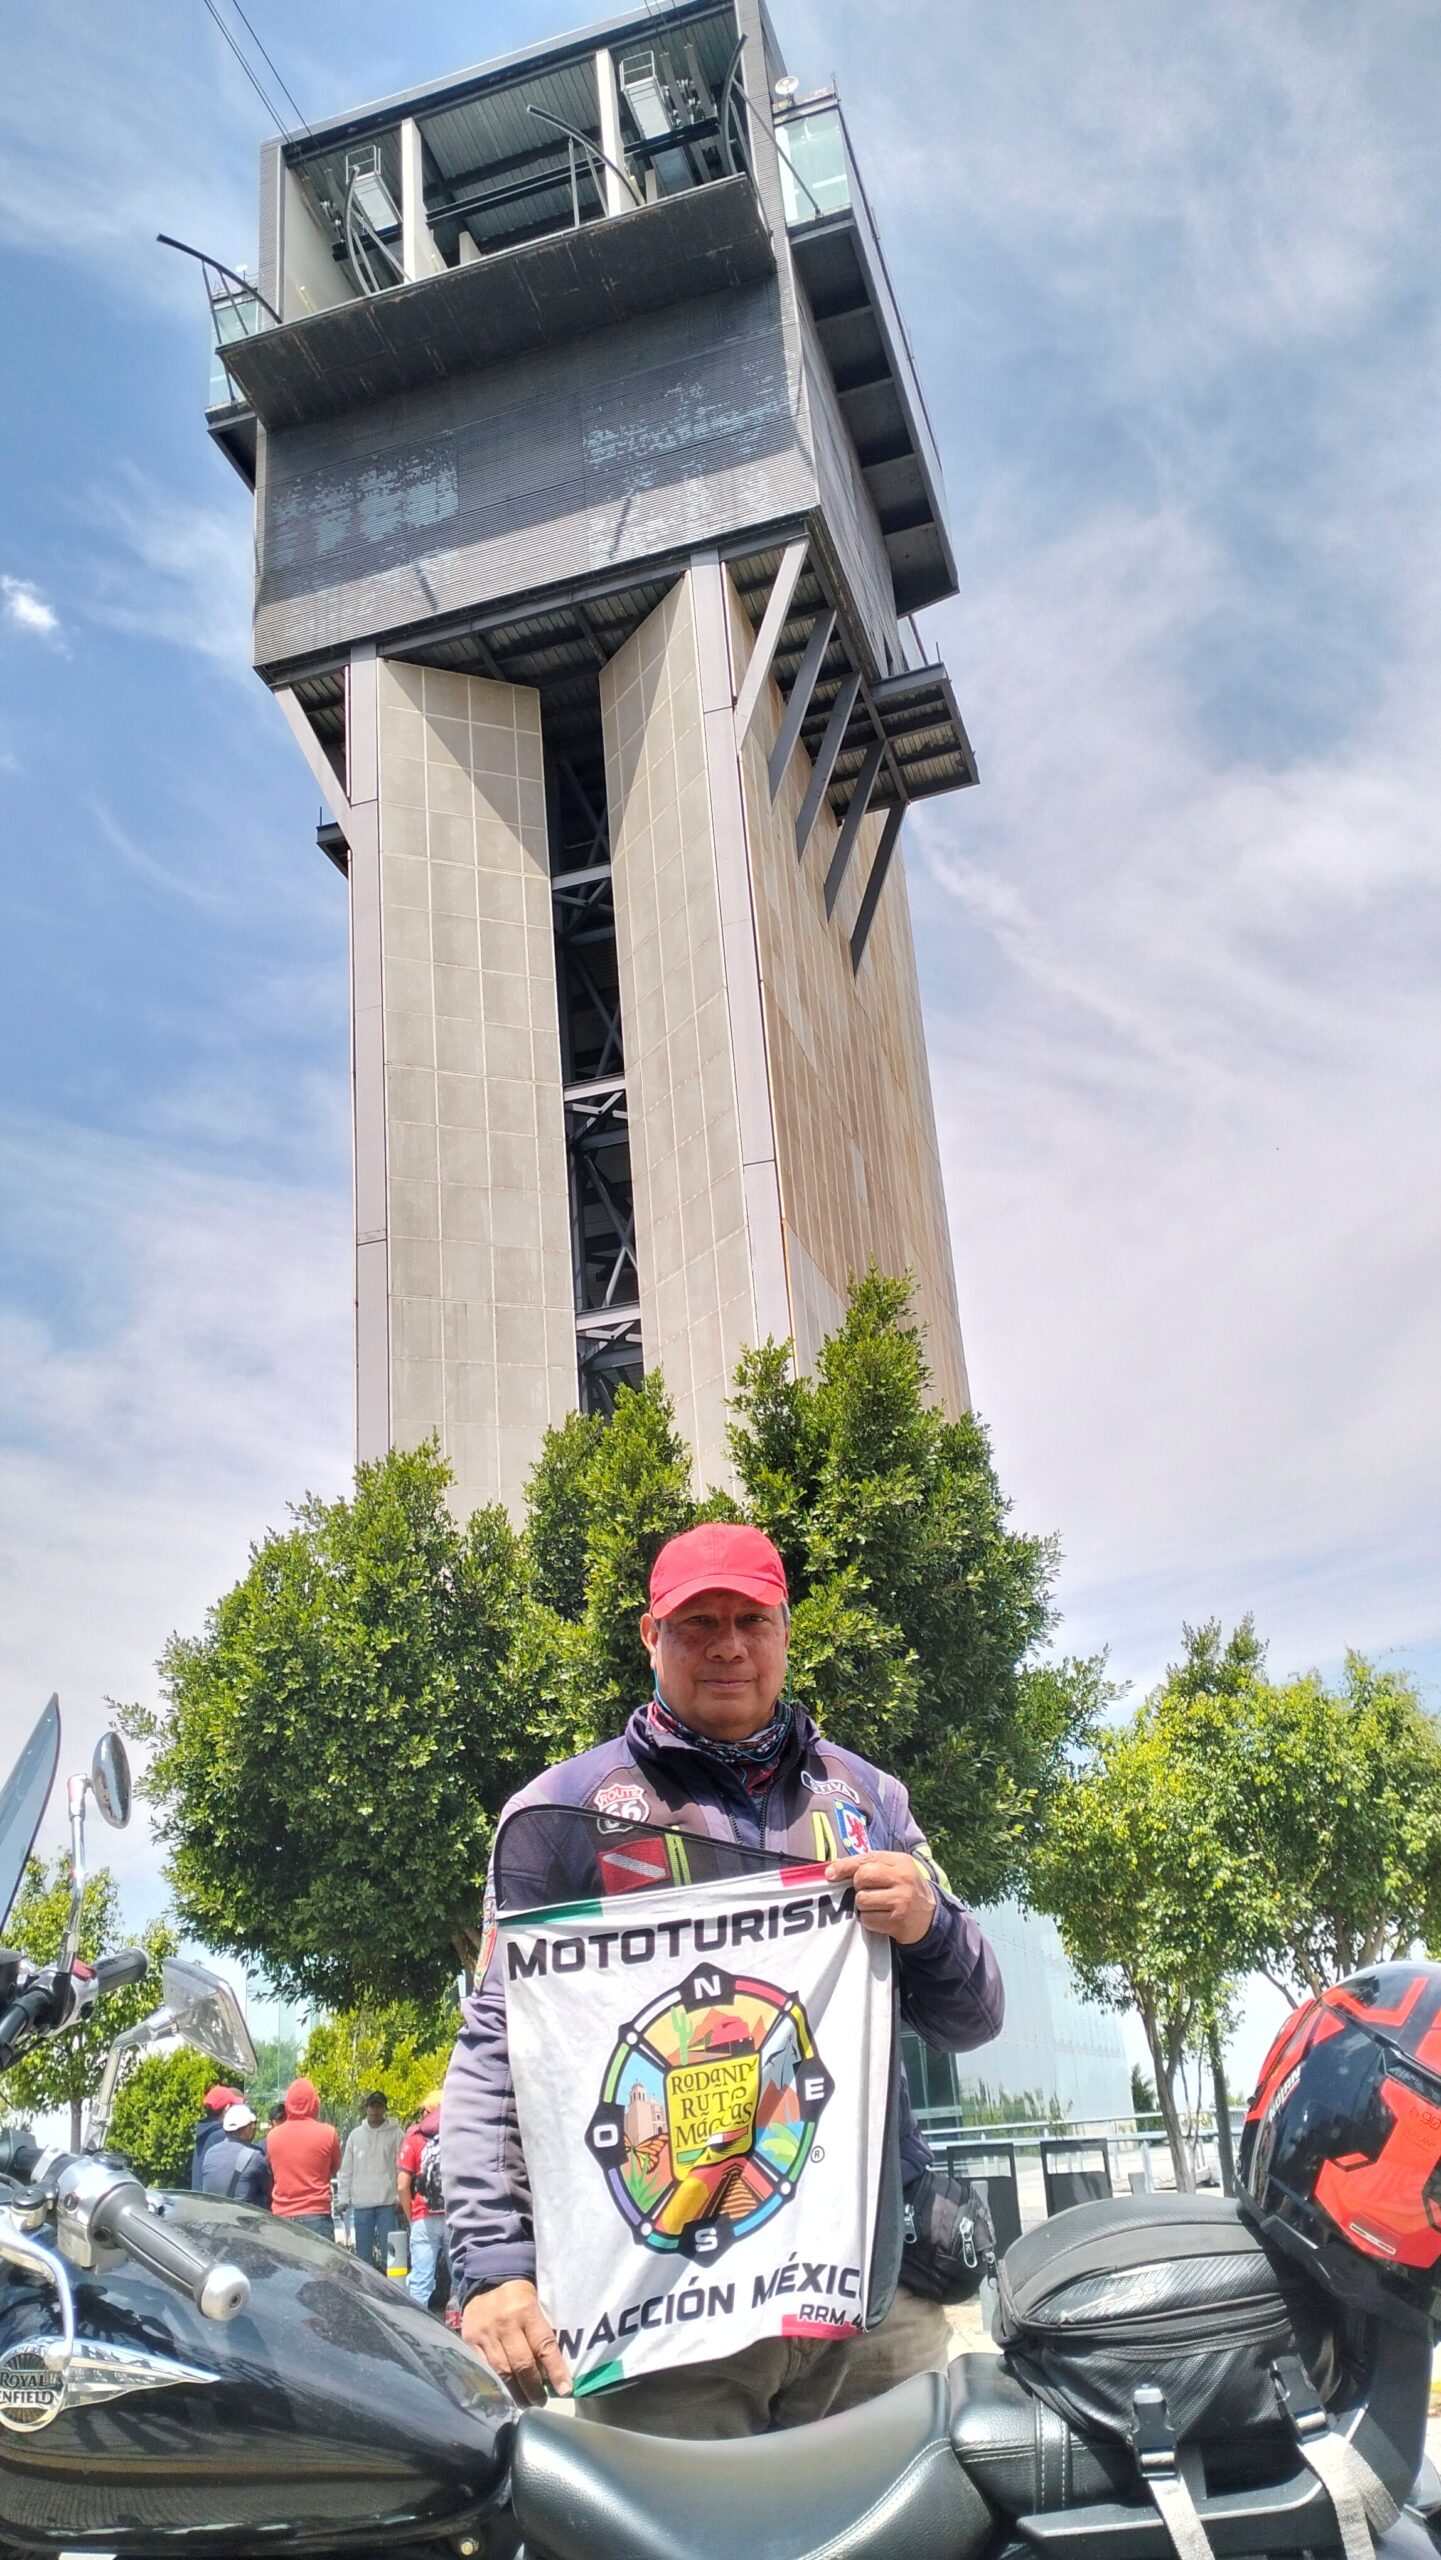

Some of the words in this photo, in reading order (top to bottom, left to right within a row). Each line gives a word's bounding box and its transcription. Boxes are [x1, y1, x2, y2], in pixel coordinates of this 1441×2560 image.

[599, 1788, 640, 1807] ROUTE
[604, 1801, 641, 1829] 66
[694, 1975, 721, 2000] N
[805, 2077, 825, 2101] E
[593, 2124, 618, 2148] O
[695, 2226, 718, 2252] S
[552, 2327, 585, 2361] N
[586, 2276, 736, 2351] ACCIÓN
[799, 2303, 847, 2327] RRM
[0, 2371, 49, 2388] ROYAL
